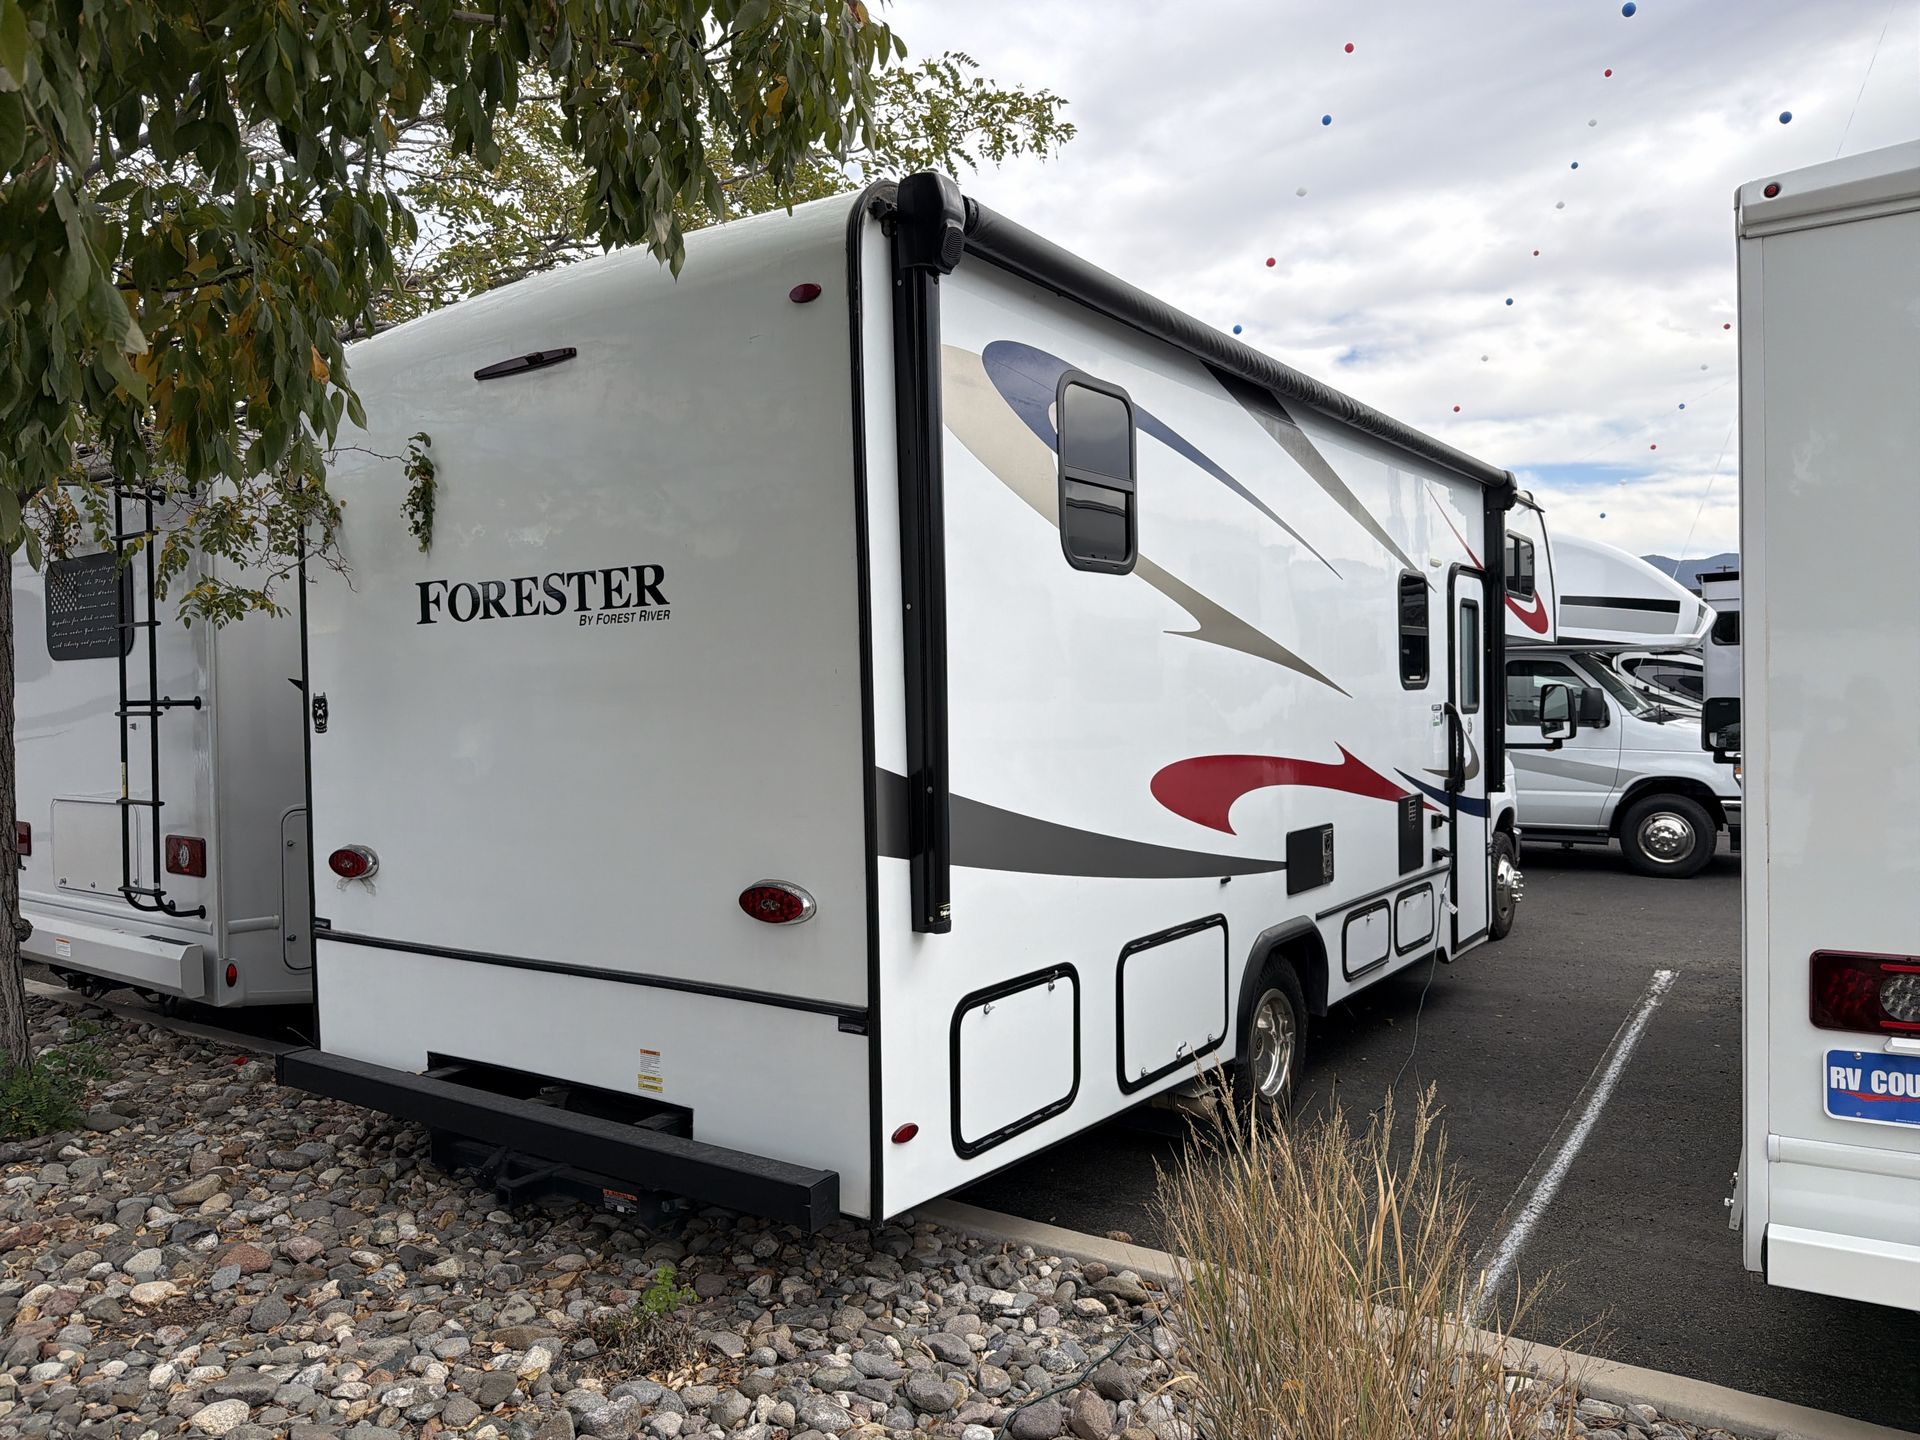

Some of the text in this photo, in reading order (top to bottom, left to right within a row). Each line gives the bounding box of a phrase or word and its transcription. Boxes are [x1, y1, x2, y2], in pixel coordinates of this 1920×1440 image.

[415, 564, 670, 625] FORESTER
[579, 609, 670, 626] BY FOREST RIVER
[1830, 1066, 1920, 1098] RV COU
